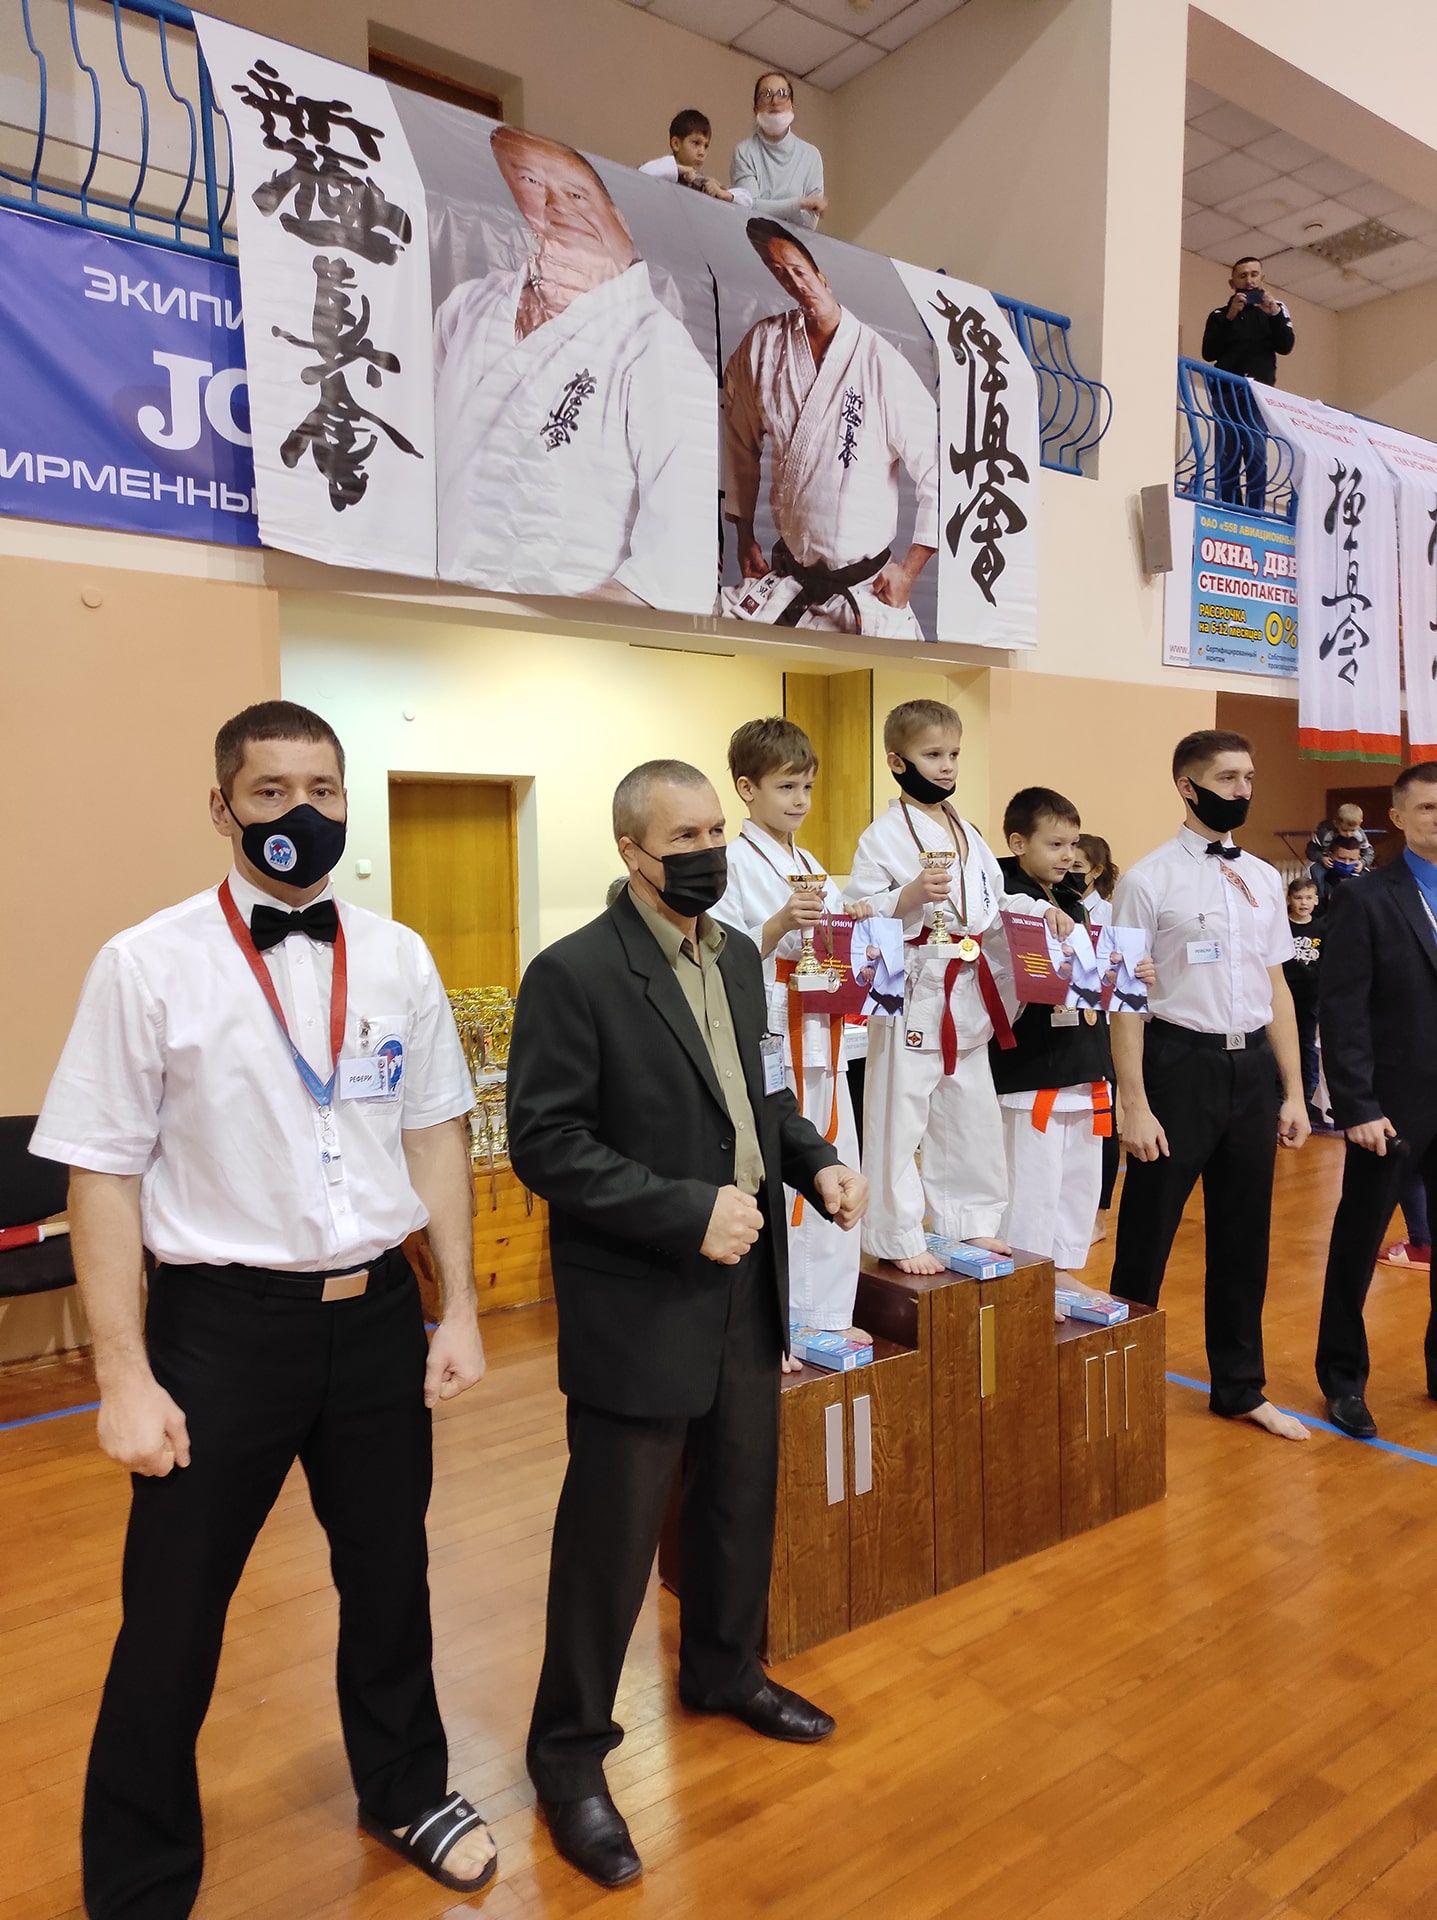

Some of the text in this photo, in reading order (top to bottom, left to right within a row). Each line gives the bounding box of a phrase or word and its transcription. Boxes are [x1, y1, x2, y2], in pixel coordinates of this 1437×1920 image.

[1200, 537, 1259, 577] ОКНА,
[1198, 602, 1247, 623] РАССРОЧКА
[1198, 620, 1263, 642] на 6-12 месяцев
[1265, 611, 1298, 649] 0%
